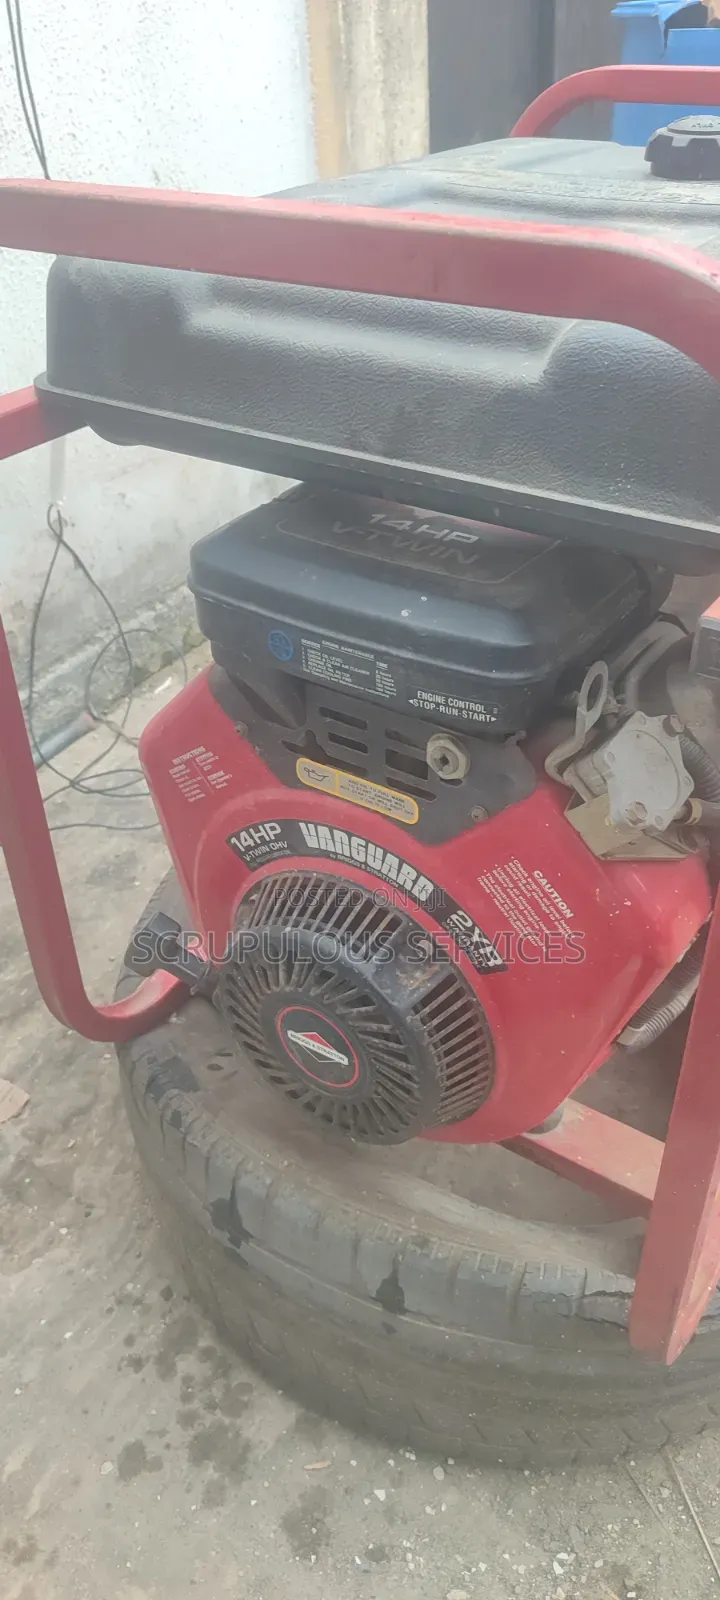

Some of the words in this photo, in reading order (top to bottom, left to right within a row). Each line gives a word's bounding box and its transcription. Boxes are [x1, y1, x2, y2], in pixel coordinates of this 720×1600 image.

[331, 521, 480, 564] V-TWIN
[369, 513, 480, 544] 14HP
[413, 699, 492, 722] STOP-RUN-START
[417, 690, 446, 705] ENGINE
[448, 697, 486, 713] CONTROL
[231, 822, 281, 852] 14HP
[243, 845, 270, 861] V-TWIN
[269, 841, 288, 850] OHV
[298, 822, 435, 901] VANGUARD
[337, 854, 361, 867] BRIGGS
[366, 867, 399, 887] STRATTON
[504, 864, 519, 881] could
[480, 875, 505, 904] connected
[508, 910, 518, 921] the
[485, 873, 497, 884] The
[494, 884, 516, 910] electrical
[513, 909, 529, 926] outlet
[492, 869, 509, 888] before
[506, 888, 526, 910] starting
[495, 867, 515, 888] Unplug
[518, 895, 541, 922] electrical
[507, 861, 528, 884] starting
[530, 891, 551, 914] damage
[513, 859, 530, 878] Check
[526, 878, 545, 898] engine
[548, 905, 562, 920] level
[533, 869, 575, 919] CAUTION
